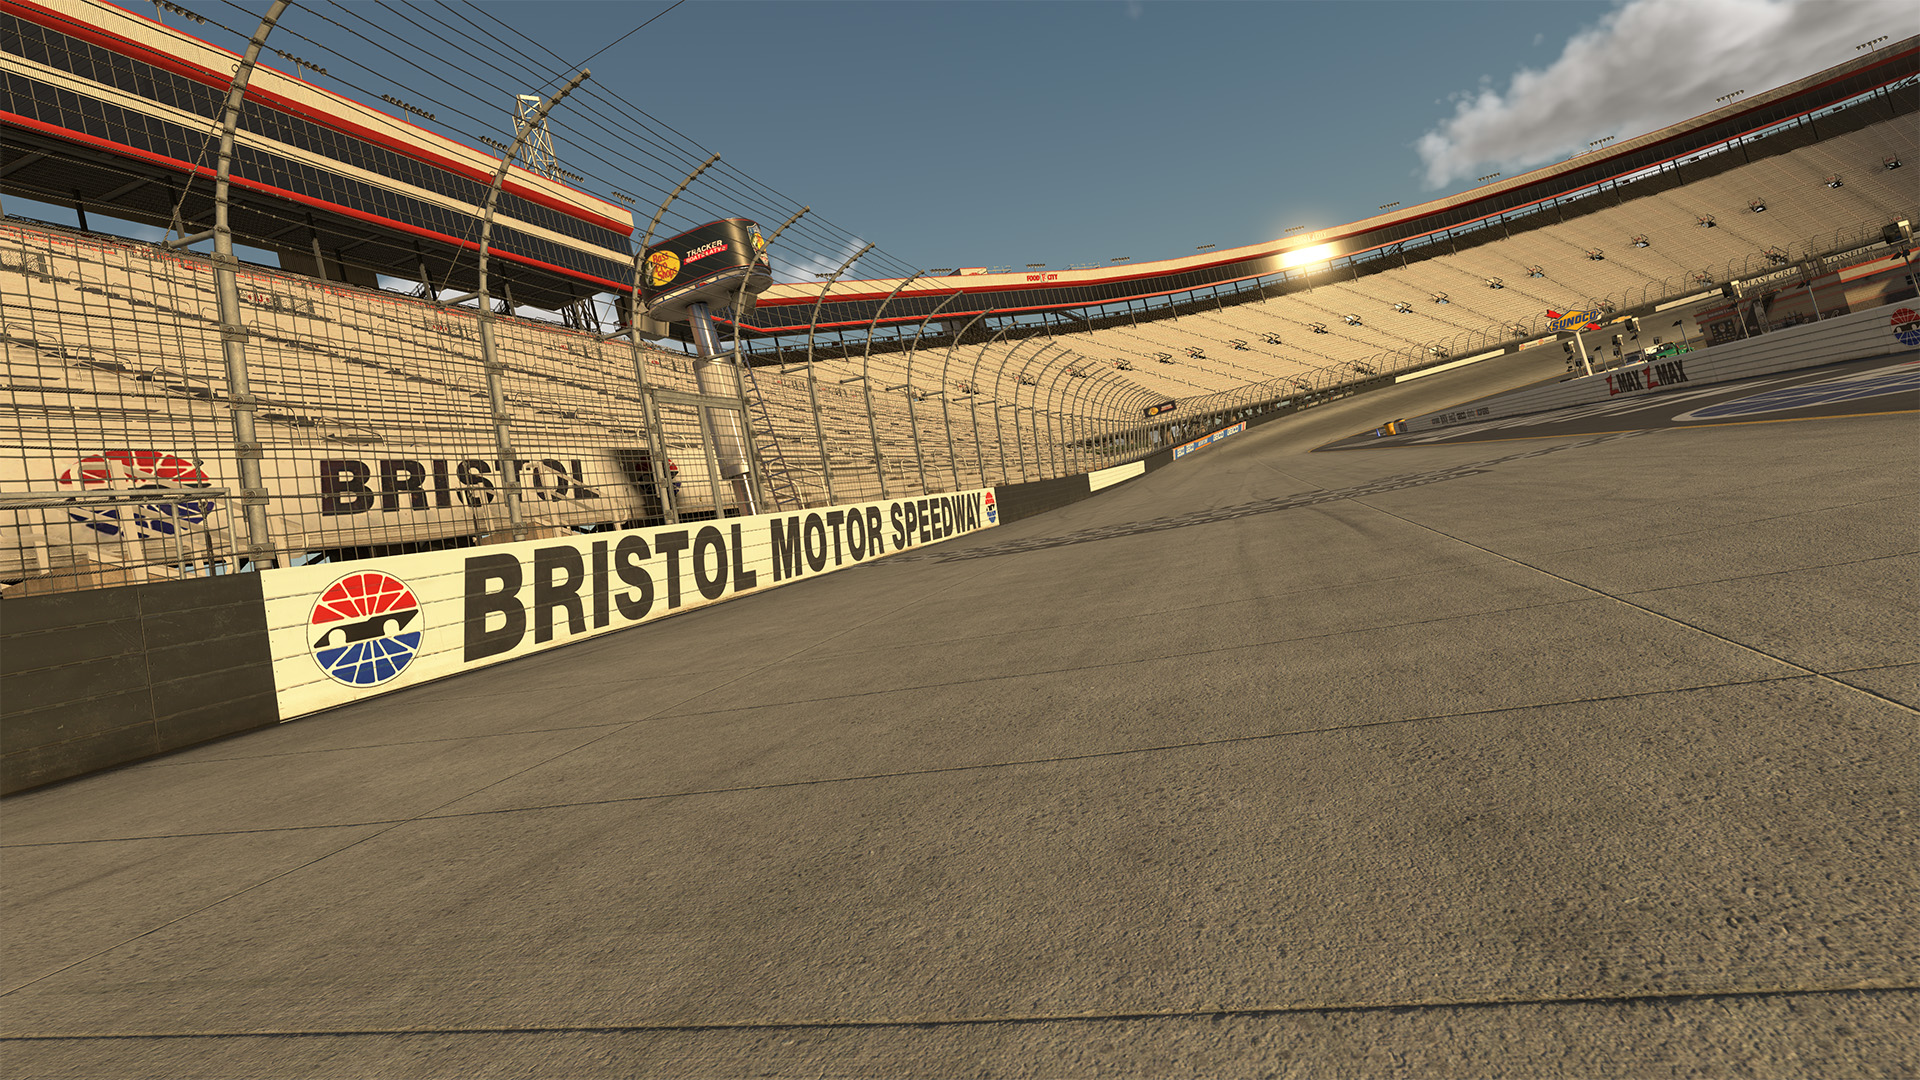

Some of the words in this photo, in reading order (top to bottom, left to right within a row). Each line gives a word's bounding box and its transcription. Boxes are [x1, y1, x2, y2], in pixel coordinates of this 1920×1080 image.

[652, 252, 669, 263] Bass
[686, 240, 723, 257] TRACKER
[1823, 246, 1873, 264] LOSSEUM
[1773, 268, 1799, 280] GRE
[1551, 310, 1597, 330] SUNOCO
[1605, 370, 1644, 396] ZMAX
[1642, 359, 1689, 390] ZMAX
[463, 524, 758, 664] BRISTOL
[770, 504, 883, 583] MOTOR
[890, 492, 981, 551] SPEEDWAY
